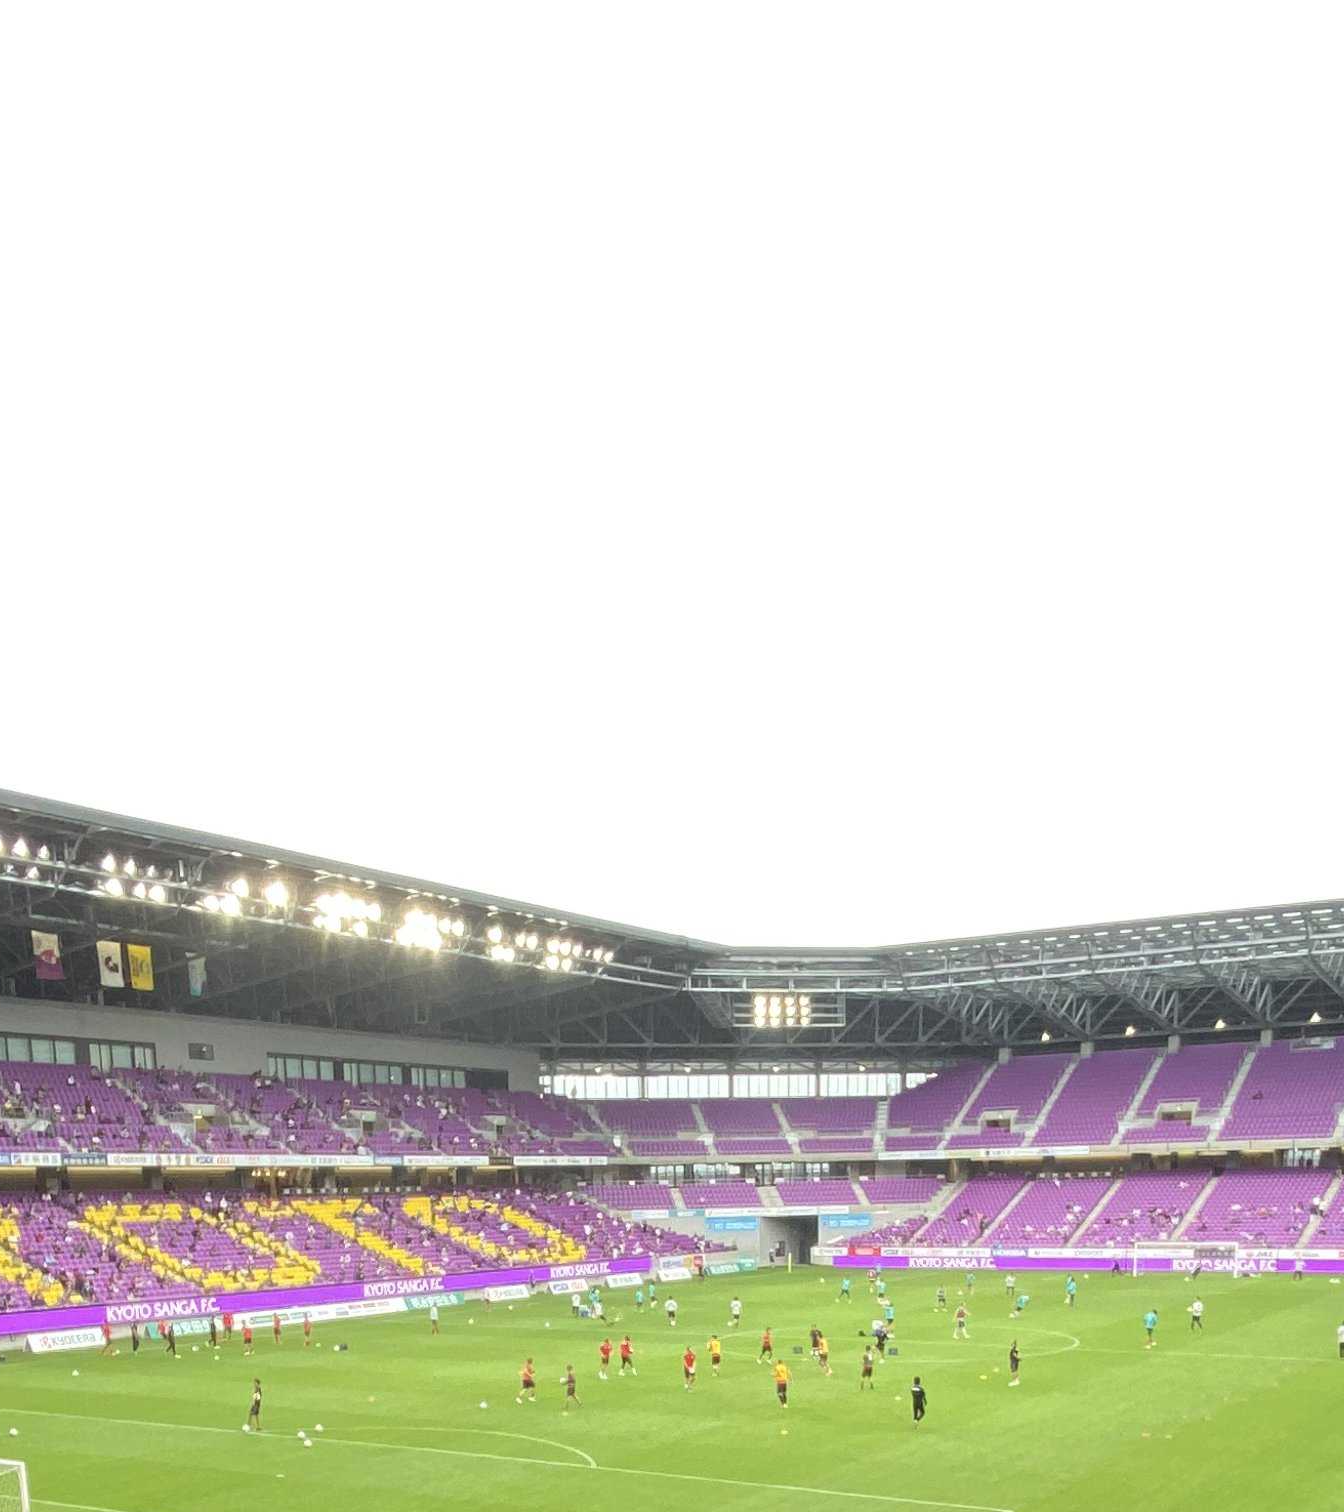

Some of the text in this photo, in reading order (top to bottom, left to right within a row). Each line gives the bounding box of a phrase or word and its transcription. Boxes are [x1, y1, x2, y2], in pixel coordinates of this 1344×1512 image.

[909, 1256, 943, 1268] KYOTO
[943, 1256, 979, 1268] SANGA
[550, 1265, 574, 1279] KYOTO
[574, 1263, 600, 1277] SANGA
[364, 1278, 445, 1298] KYOTO SANGA F.C.
[107, 1298, 221, 1322] KYOTO SANGA F.C.
[51, 1332, 97, 1347] KYOCERA
